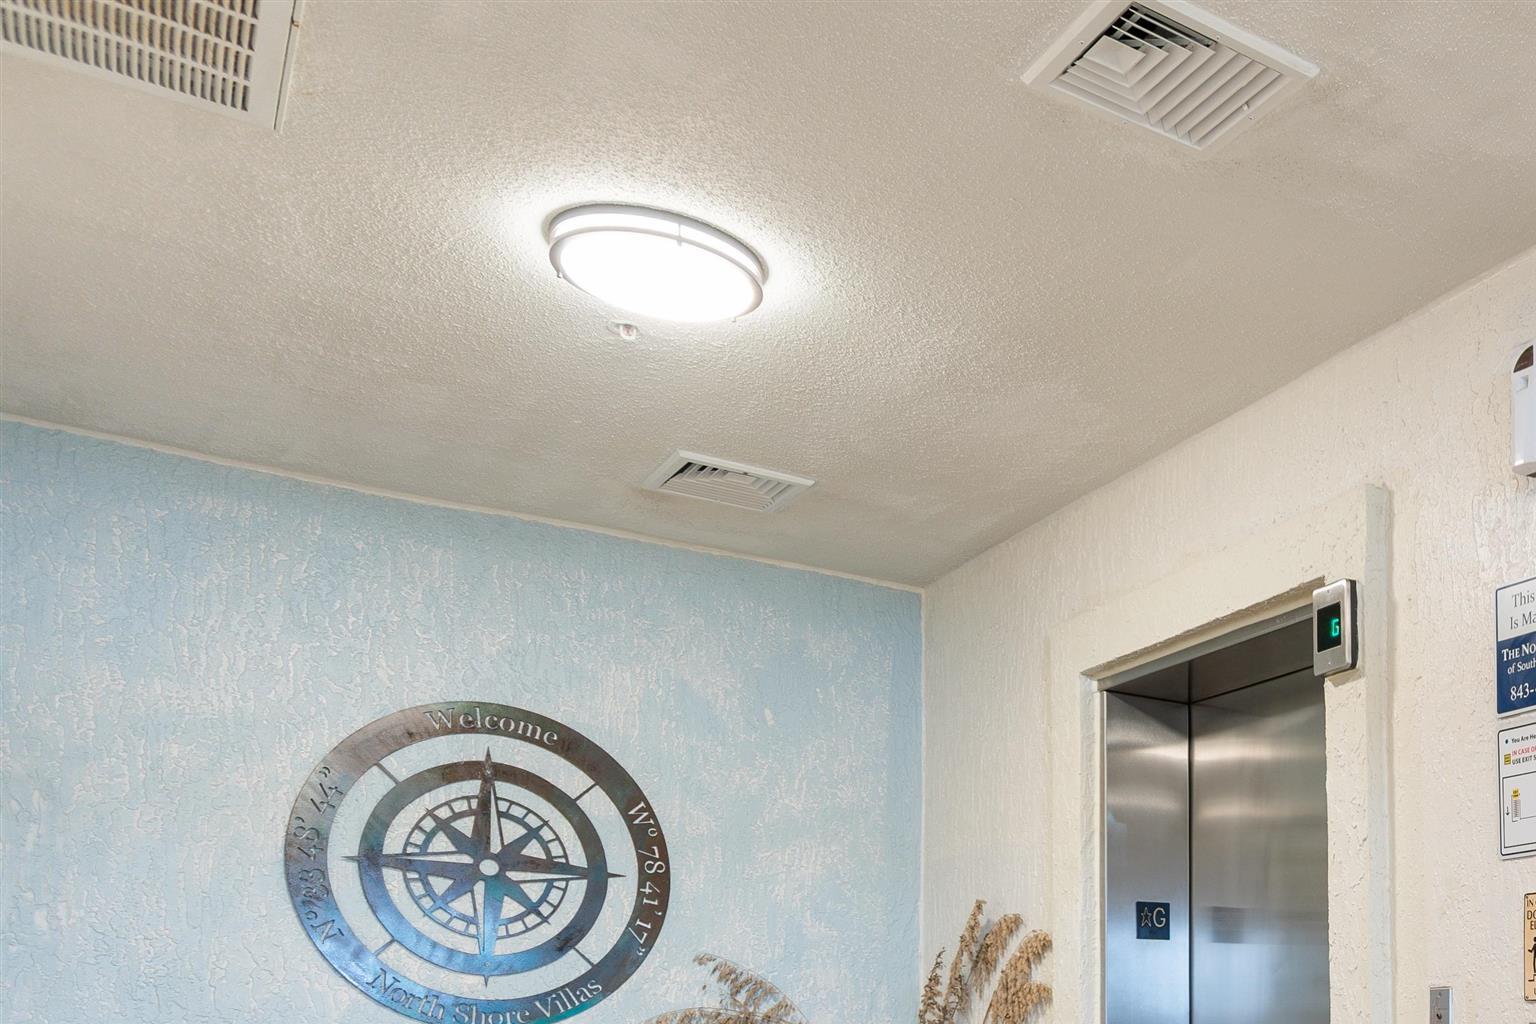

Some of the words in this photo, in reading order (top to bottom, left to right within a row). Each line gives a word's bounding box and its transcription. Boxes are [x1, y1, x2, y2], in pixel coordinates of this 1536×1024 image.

[1511, 591, 1535, 608] This
[1331, 618, 1340, 637] G
[1510, 616, 1518, 630] Is
[1502, 648, 1520, 661] THE
[1507, 662, 1515, 675] of
[425, 708, 558, 745] Welcome
[1512, 736, 1520, 744] You
[1518, 746, 1530, 755] CASE
[1512, 757, 1521, 765] USE
[1522, 755, 1532, 763] EXIT
[637, 846, 666, 874] 78
[1527, 899, 1534, 907] IN
[1153, 907, 1166, 928] G
[366, 967, 445, 1021] North
[534, 976, 603, 1020] Villas
